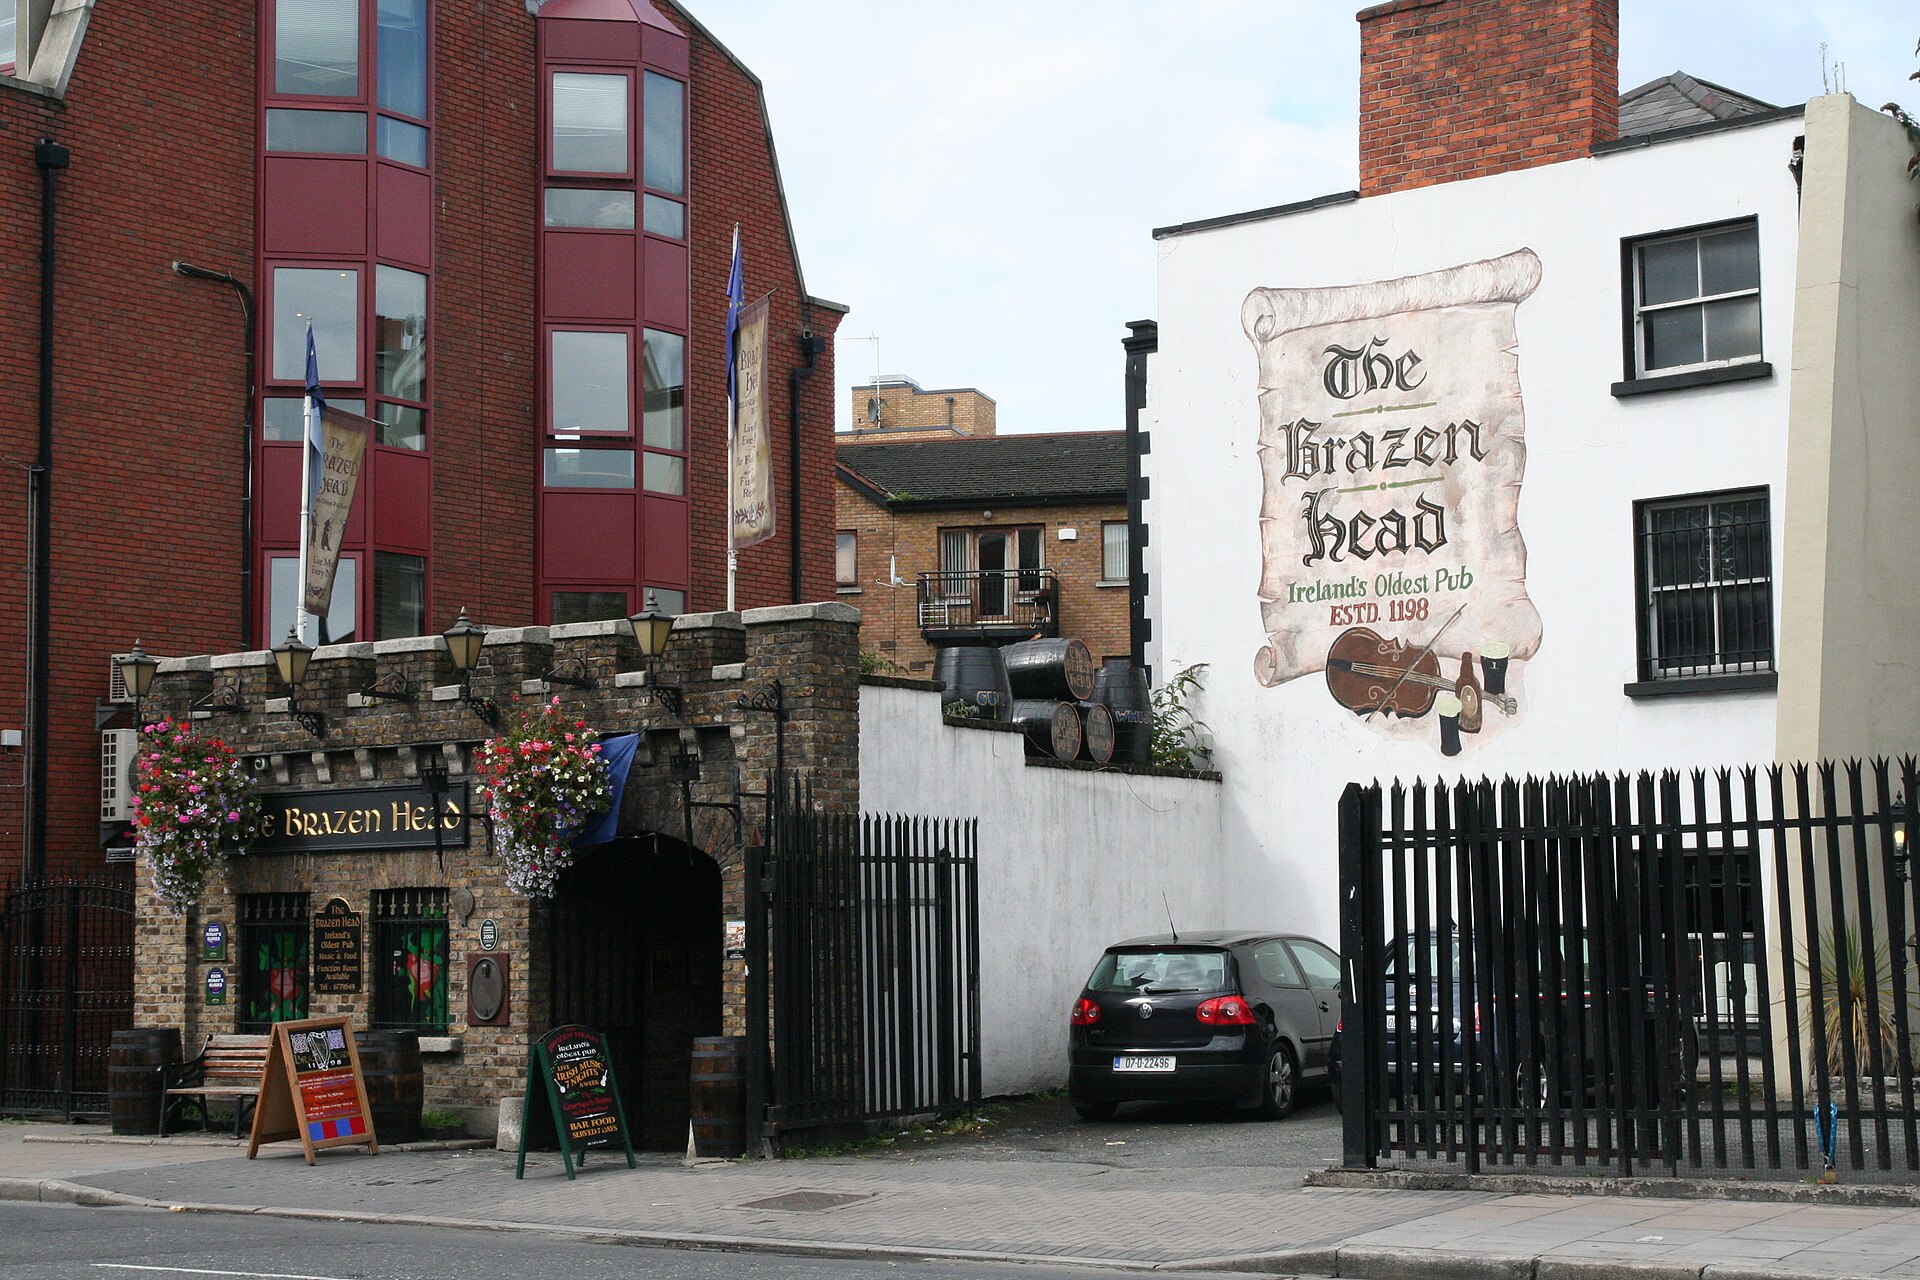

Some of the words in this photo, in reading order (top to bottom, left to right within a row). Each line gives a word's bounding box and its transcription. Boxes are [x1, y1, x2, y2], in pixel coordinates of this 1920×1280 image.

[1321, 334, 1428, 400] The
[1278, 417, 1491, 487] Brazen
[1301, 487, 1449, 567] Head
[1287, 576, 1368, 605] Ireland's
[1374, 570, 1431, 598] Oldest
[1434, 565, 1475, 593] Pub
[1329, 603, 1382, 627] ESTD.
[1389, 598, 1430, 623] 1198
[284, 807, 381, 837] BRAZEN
[332, 906, 344, 914] The
[315, 919, 340, 928] BRAZEN
[342, 916, 360, 928] HEAD
[556, 1067, 579, 1081] IRISH
[579, 1059, 604, 1071] MUSIC
[1125, 1057, 1170, 1069] 07-D-22496
[570, 1068, 599, 1087] NIGHTS
[569, 1120, 589, 1131] BAR
[591, 1116, 616, 1127] FOOD
[572, 1128, 597, 1139] SERVED
